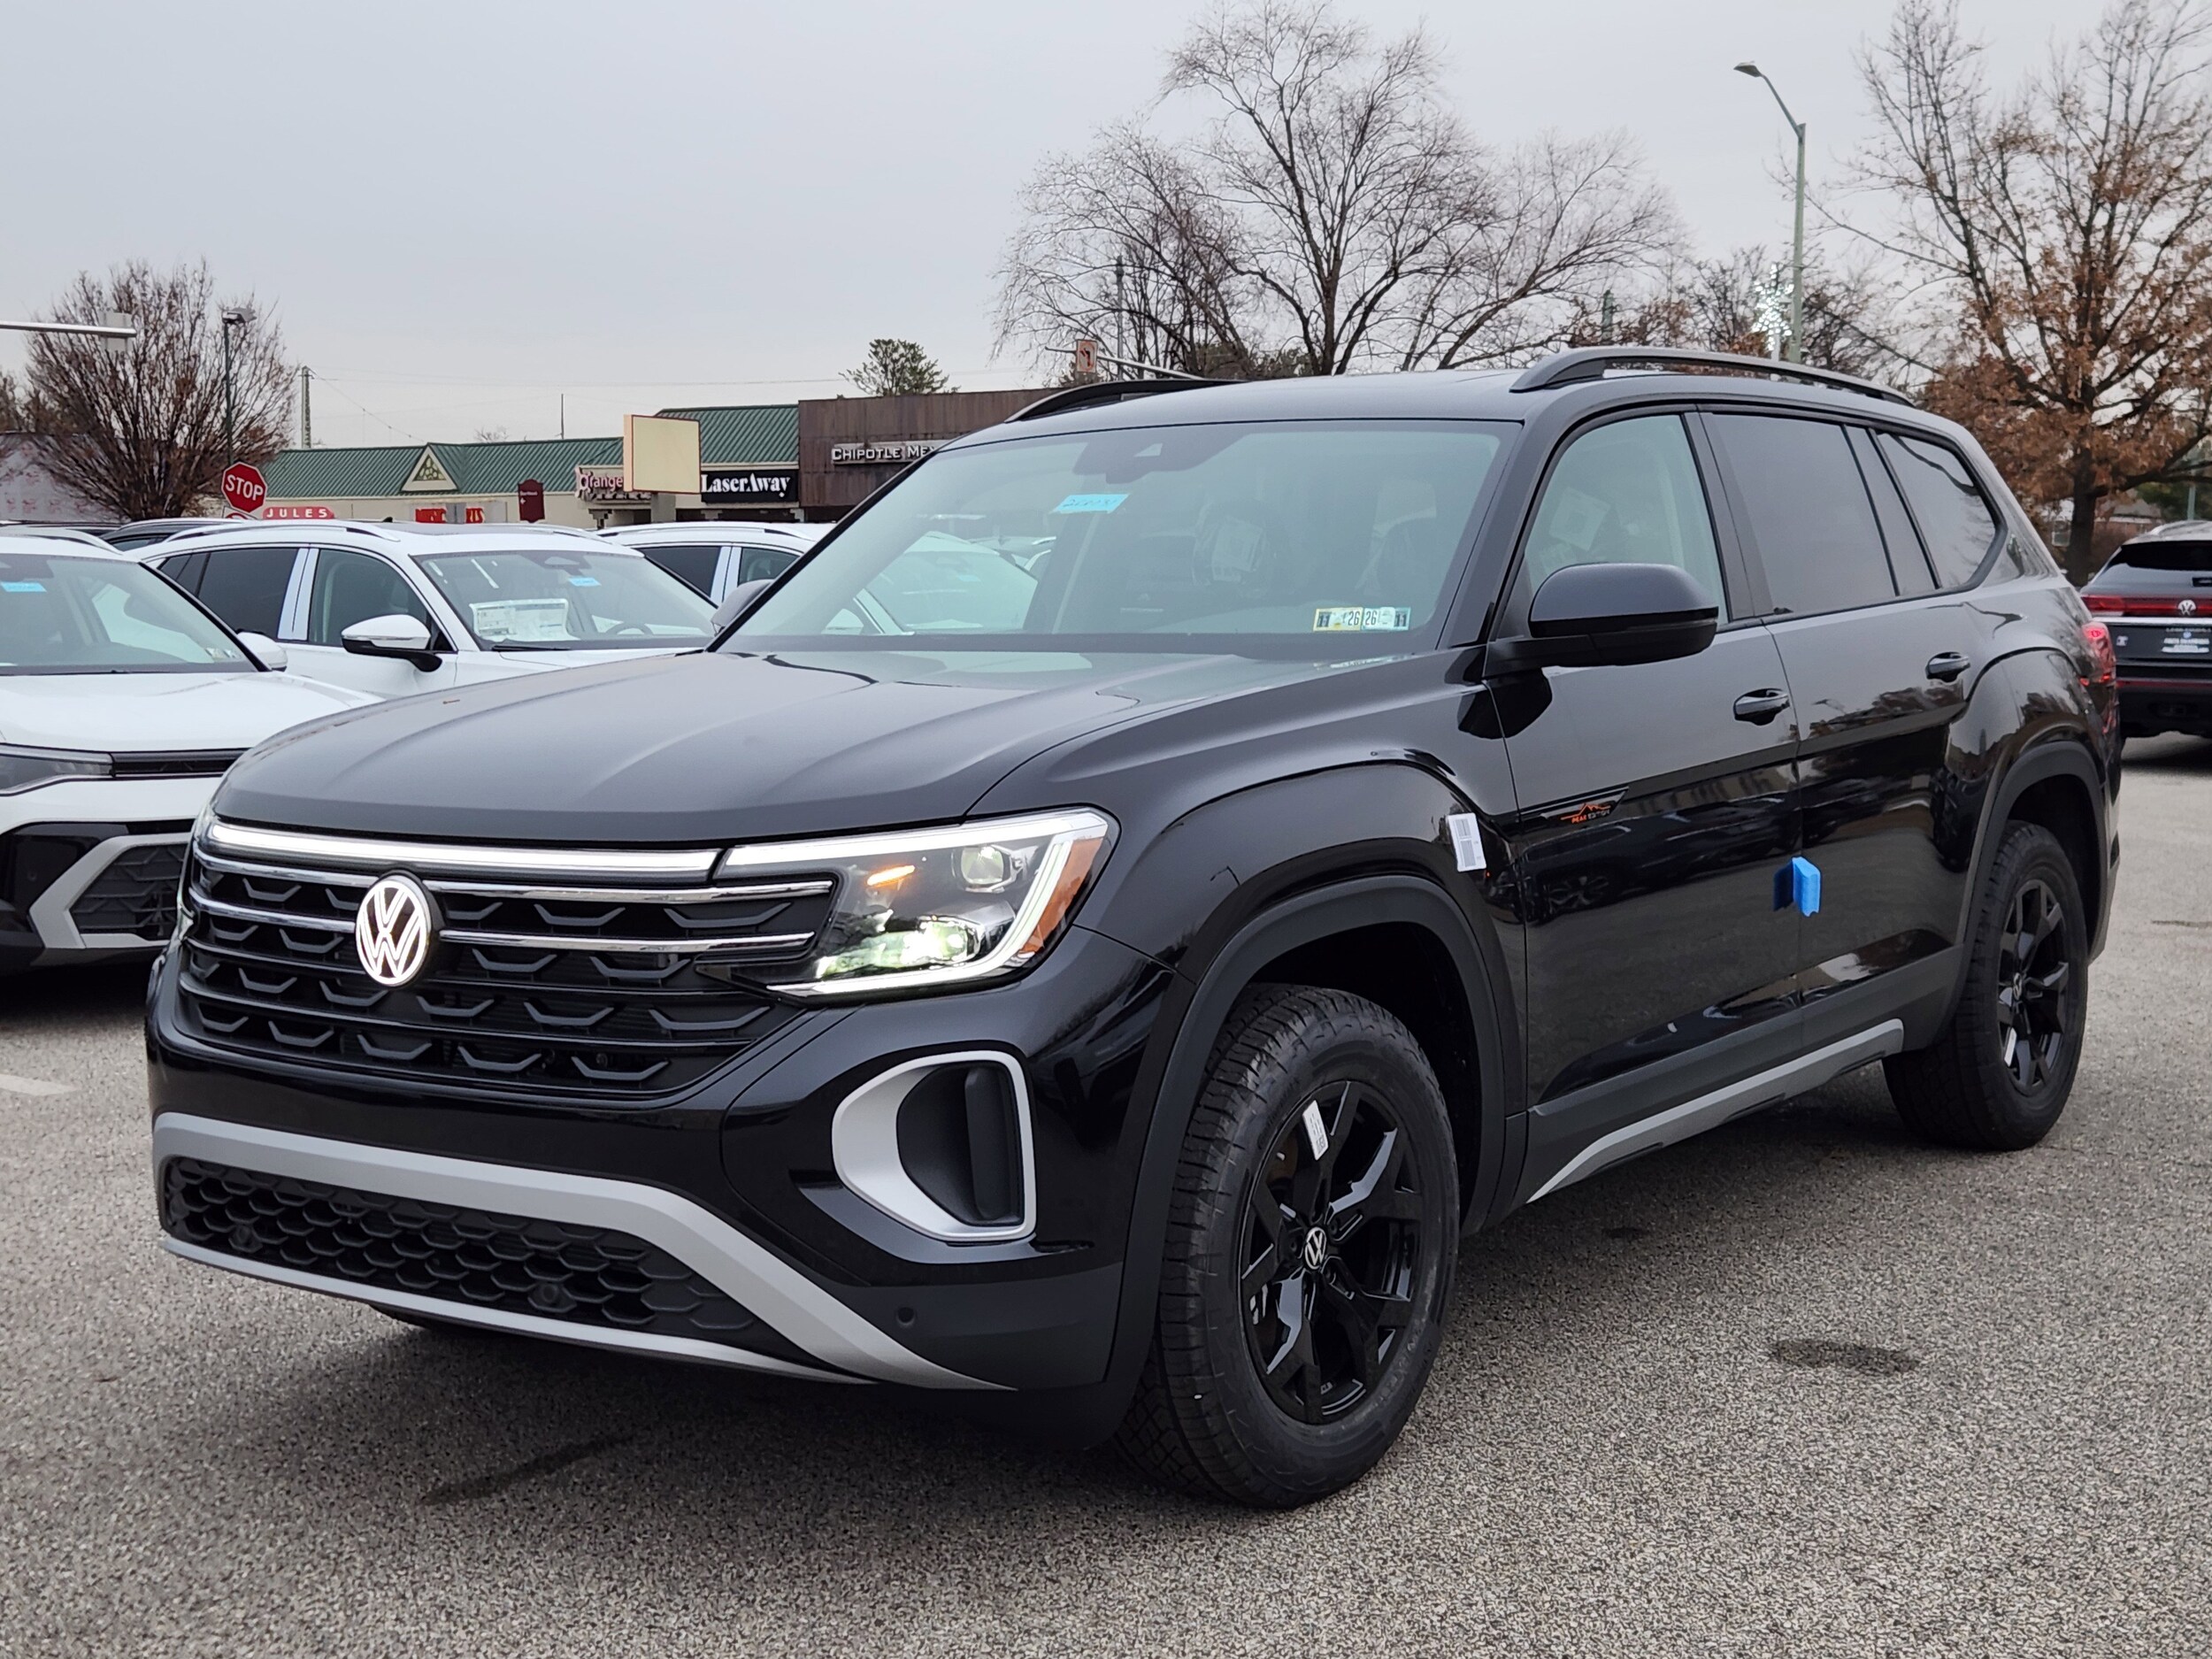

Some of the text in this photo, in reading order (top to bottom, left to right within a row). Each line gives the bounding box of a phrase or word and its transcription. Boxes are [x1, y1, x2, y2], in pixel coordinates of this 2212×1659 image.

[832, 448, 901, 461] CHIPOTLE
[225, 474, 264, 501] STOP
[701, 472, 791, 497] LaserAway
[266, 508, 328, 518] JULES
[1348, 611, 1361, 626] 26
[1364, 610, 1378, 626] 26
